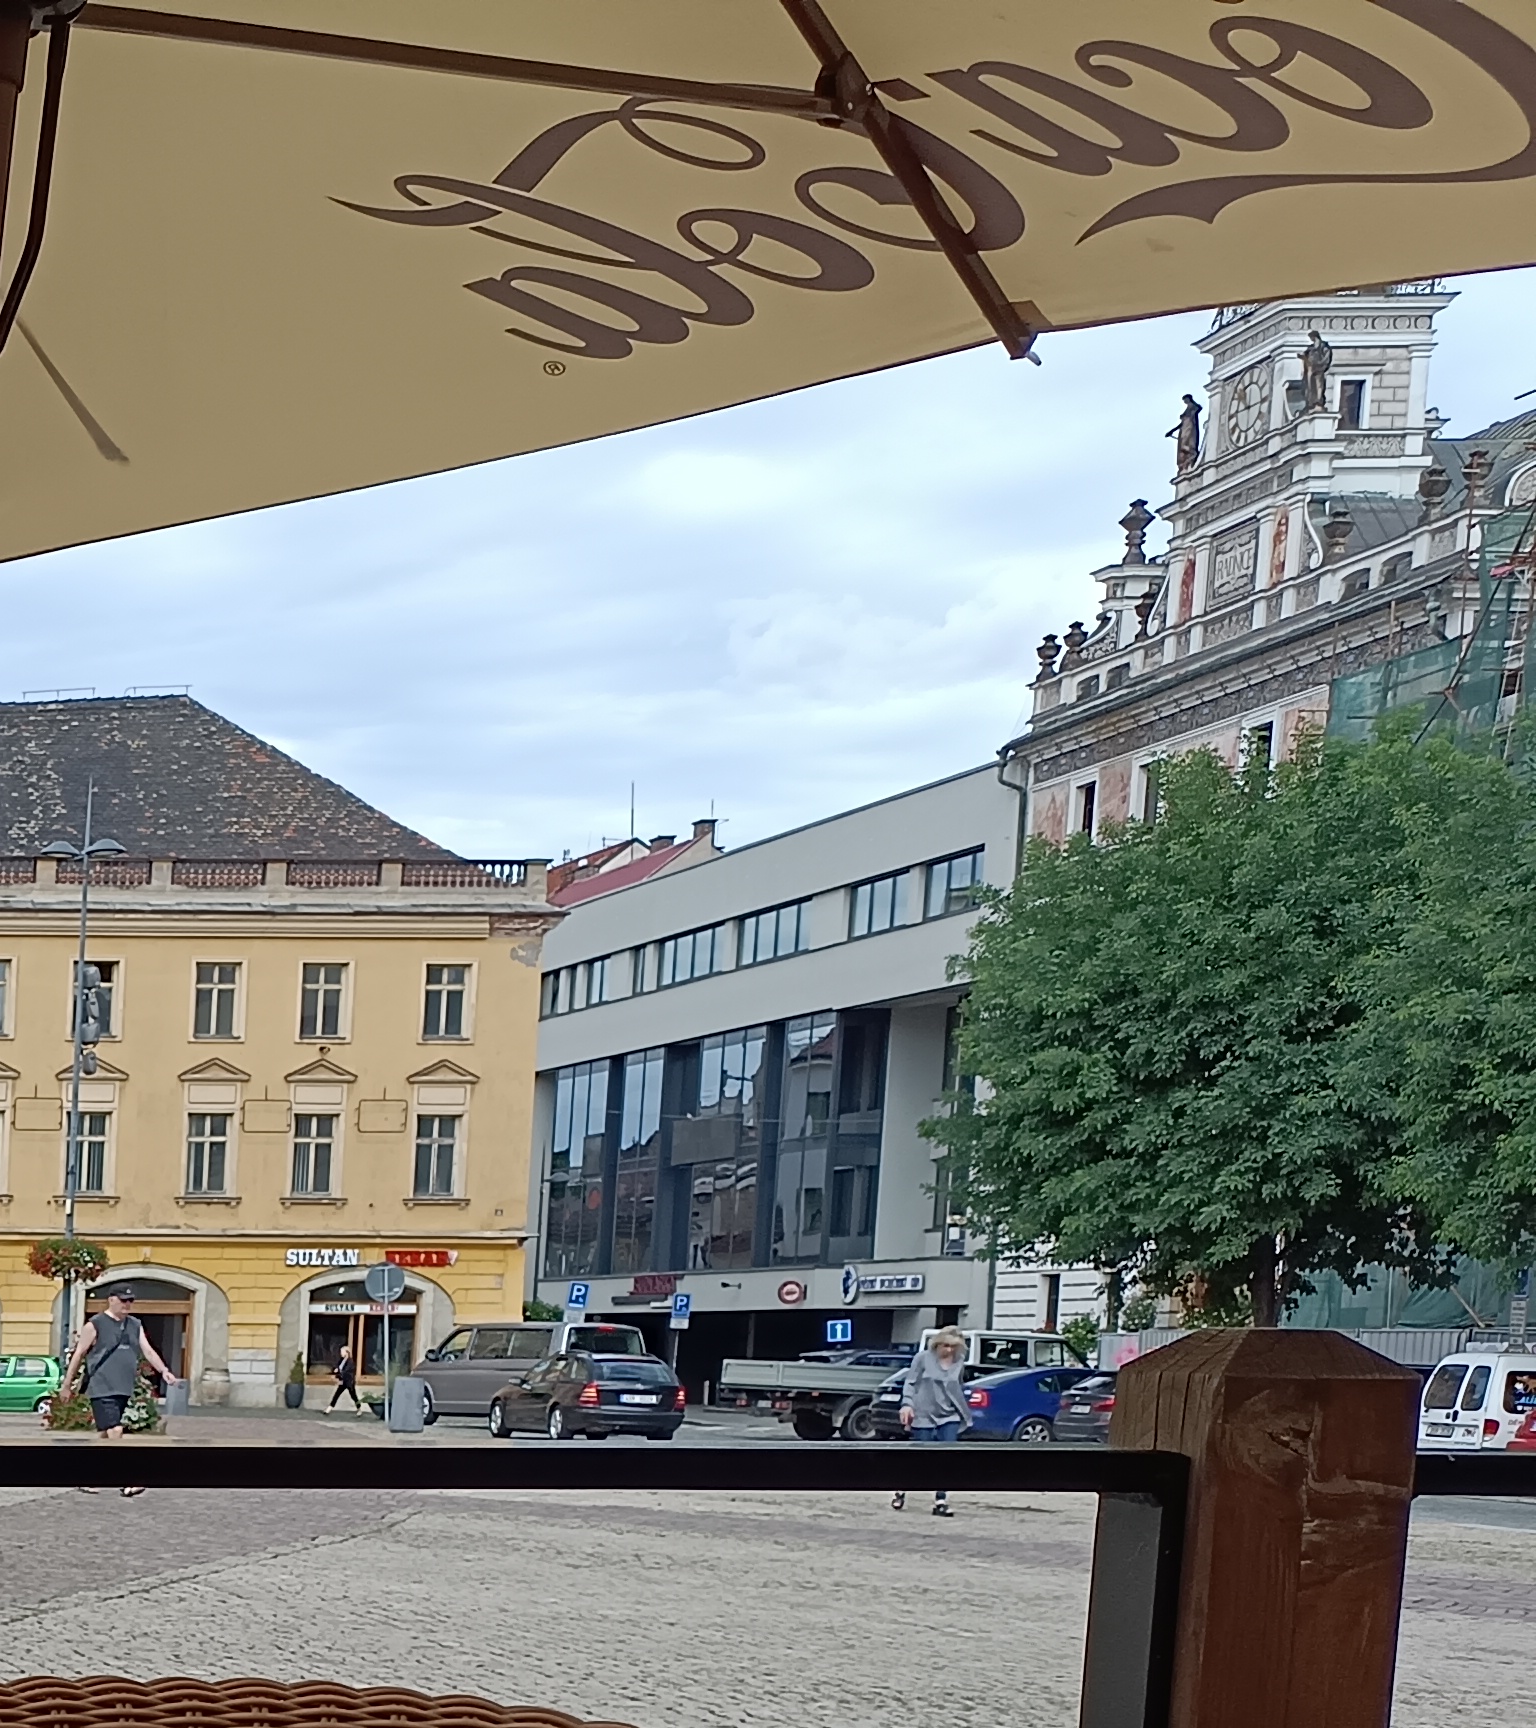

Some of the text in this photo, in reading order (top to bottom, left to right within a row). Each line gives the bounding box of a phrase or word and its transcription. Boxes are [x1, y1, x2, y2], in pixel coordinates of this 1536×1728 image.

[286, 1249, 359, 1266] SULTAN
[571, 1284, 586, 1301] P
[676, 1295, 688, 1310] P
